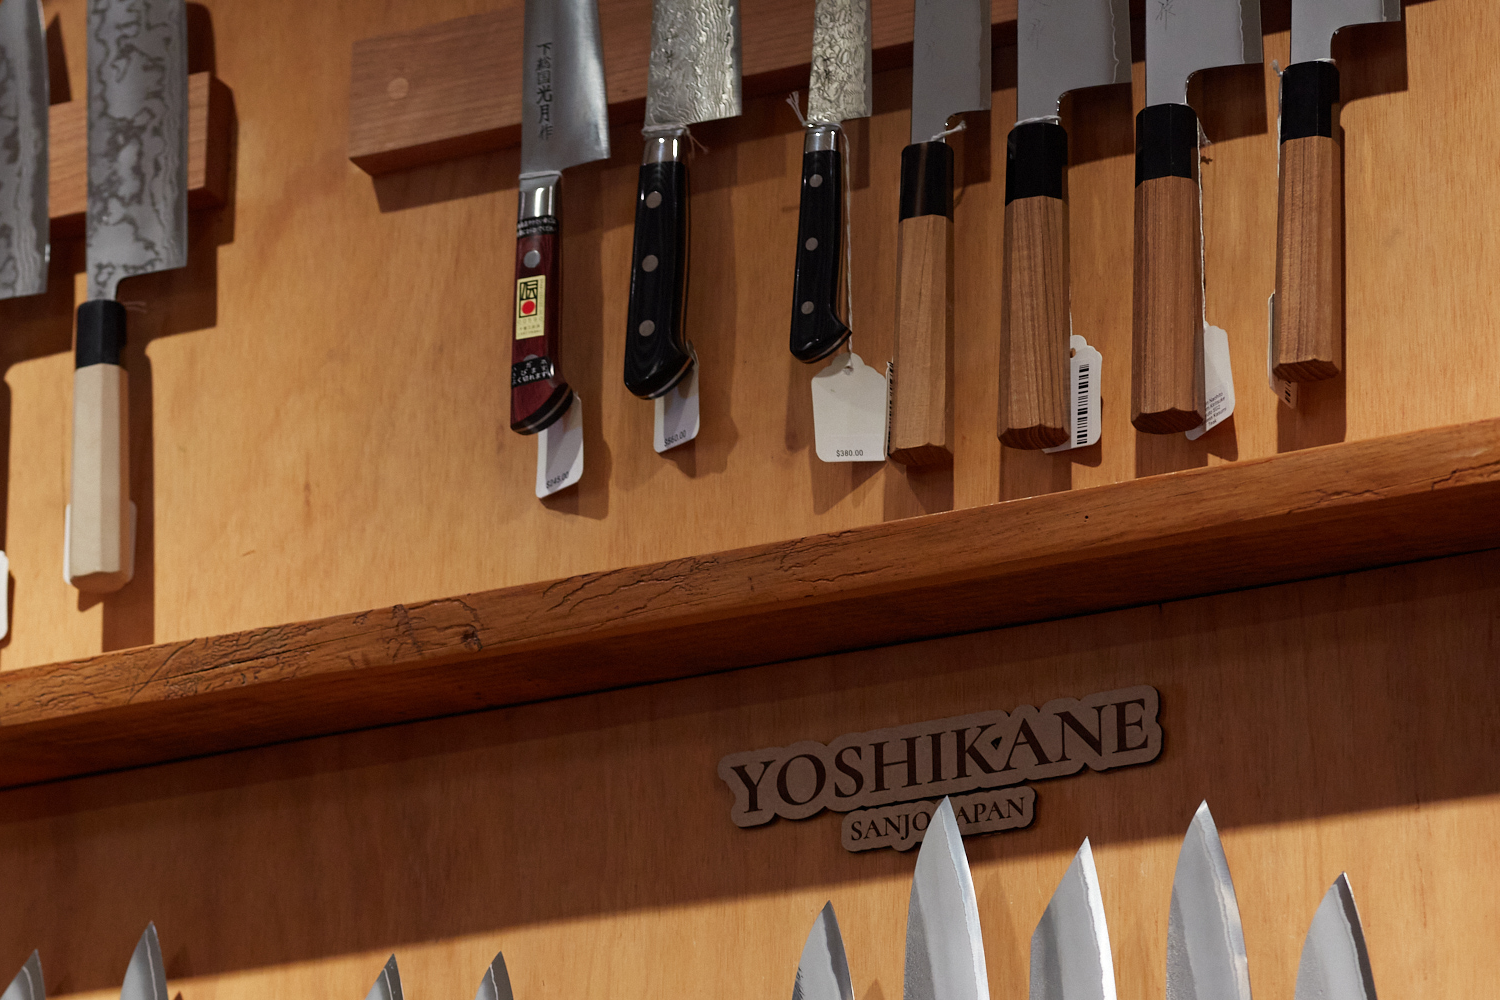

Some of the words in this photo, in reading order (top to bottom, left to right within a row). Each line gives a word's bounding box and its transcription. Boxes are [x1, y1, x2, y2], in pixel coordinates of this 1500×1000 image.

[836, 449, 864, 458] $380.00
[730, 698, 1149, 814] YOSHIKANE
[851, 811, 931, 841] SANJO
[956, 796, 1025, 826] APAN
